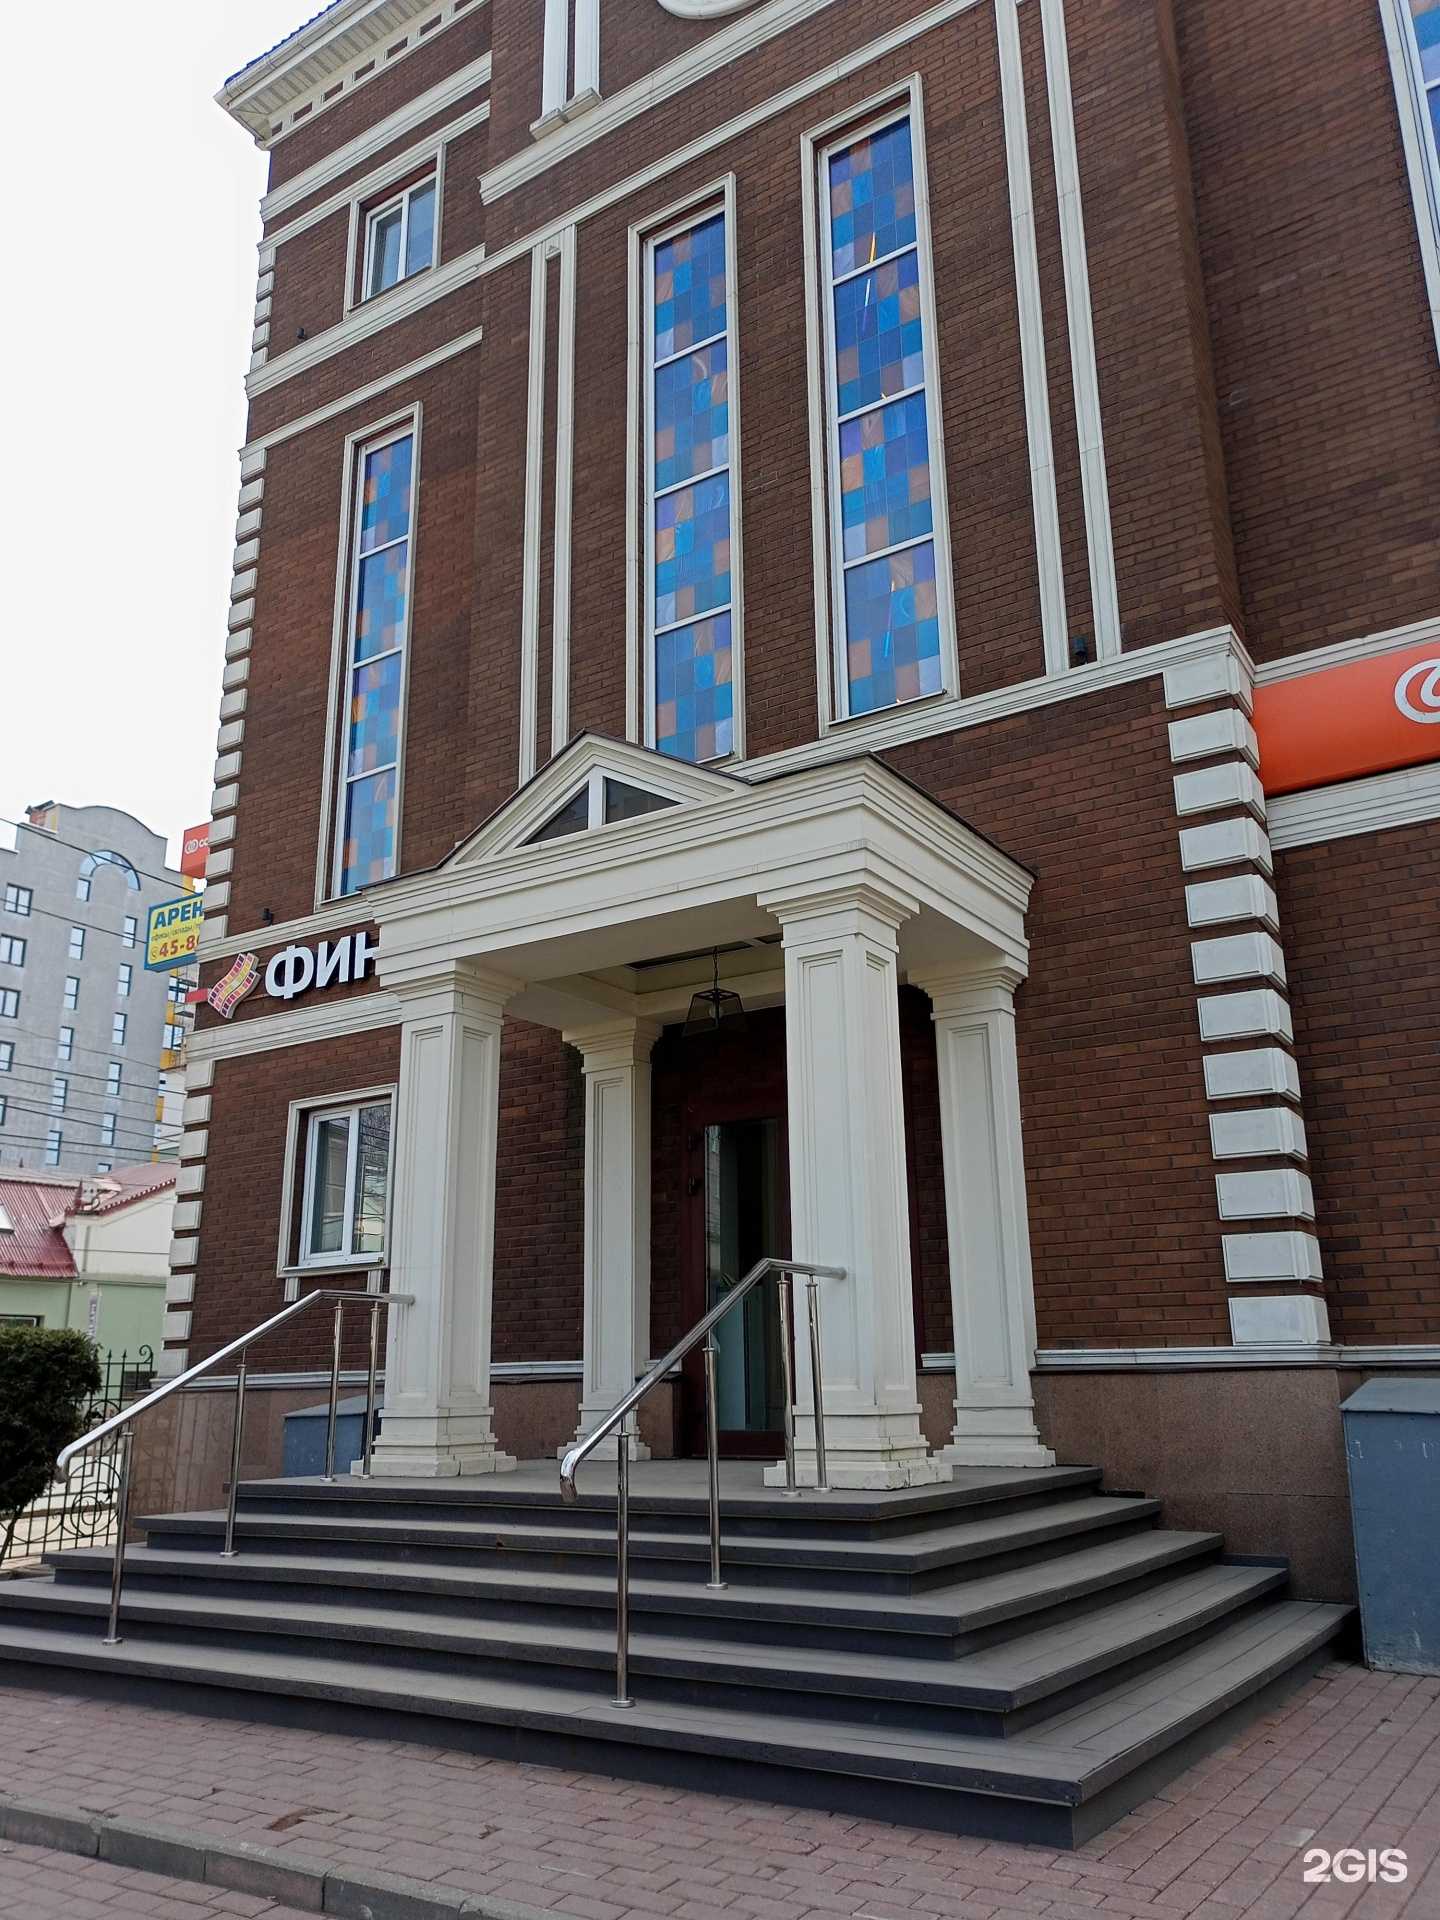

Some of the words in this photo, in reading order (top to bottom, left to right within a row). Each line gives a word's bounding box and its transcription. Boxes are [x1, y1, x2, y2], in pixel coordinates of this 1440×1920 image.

[153, 900, 203, 930] АРЕН
[159, 934, 200, 957] 45-8
[265, 931, 380, 1000] ФИН
